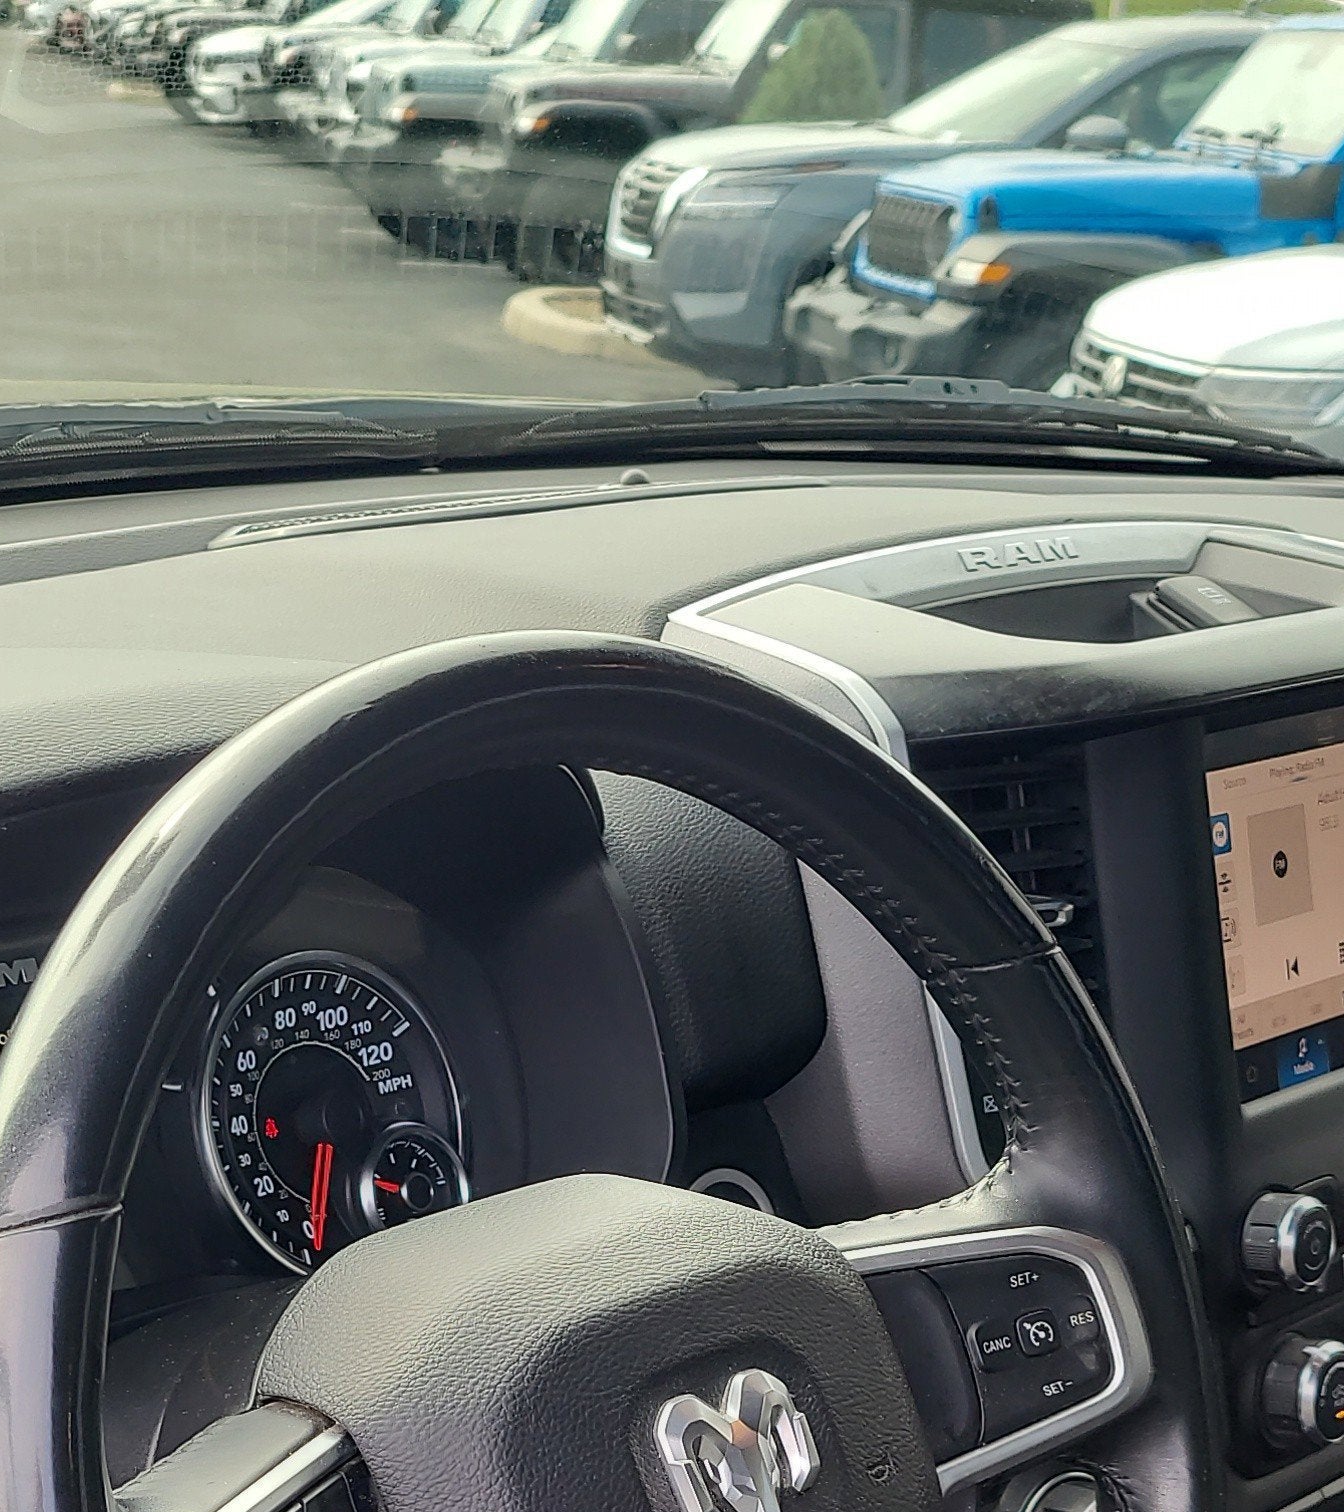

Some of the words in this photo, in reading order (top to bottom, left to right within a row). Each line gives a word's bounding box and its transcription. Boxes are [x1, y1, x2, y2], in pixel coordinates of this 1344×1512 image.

[956, 536, 1079, 573] RAM
[274, 1007, 296, 1030] 80
[301, 1001, 317, 1016] 90
[316, 1006, 348, 1031] 100
[351, 1020, 372, 1036] 110
[237, 1050, 256, 1072] 60
[358, 1042, 393, 1067] 120
[229, 1083, 242, 1097] 50
[378, 1075, 413, 1095] MPH
[231, 1115, 249, 1137] 40
[238, 1153, 252, 1168] 30
[254, 1175, 274, 1198] 20
[276, 1209, 290, 1223] 10
[1069, 1309, 1095, 1327] RES
[982, 1336, 1012, 1355] CANC
